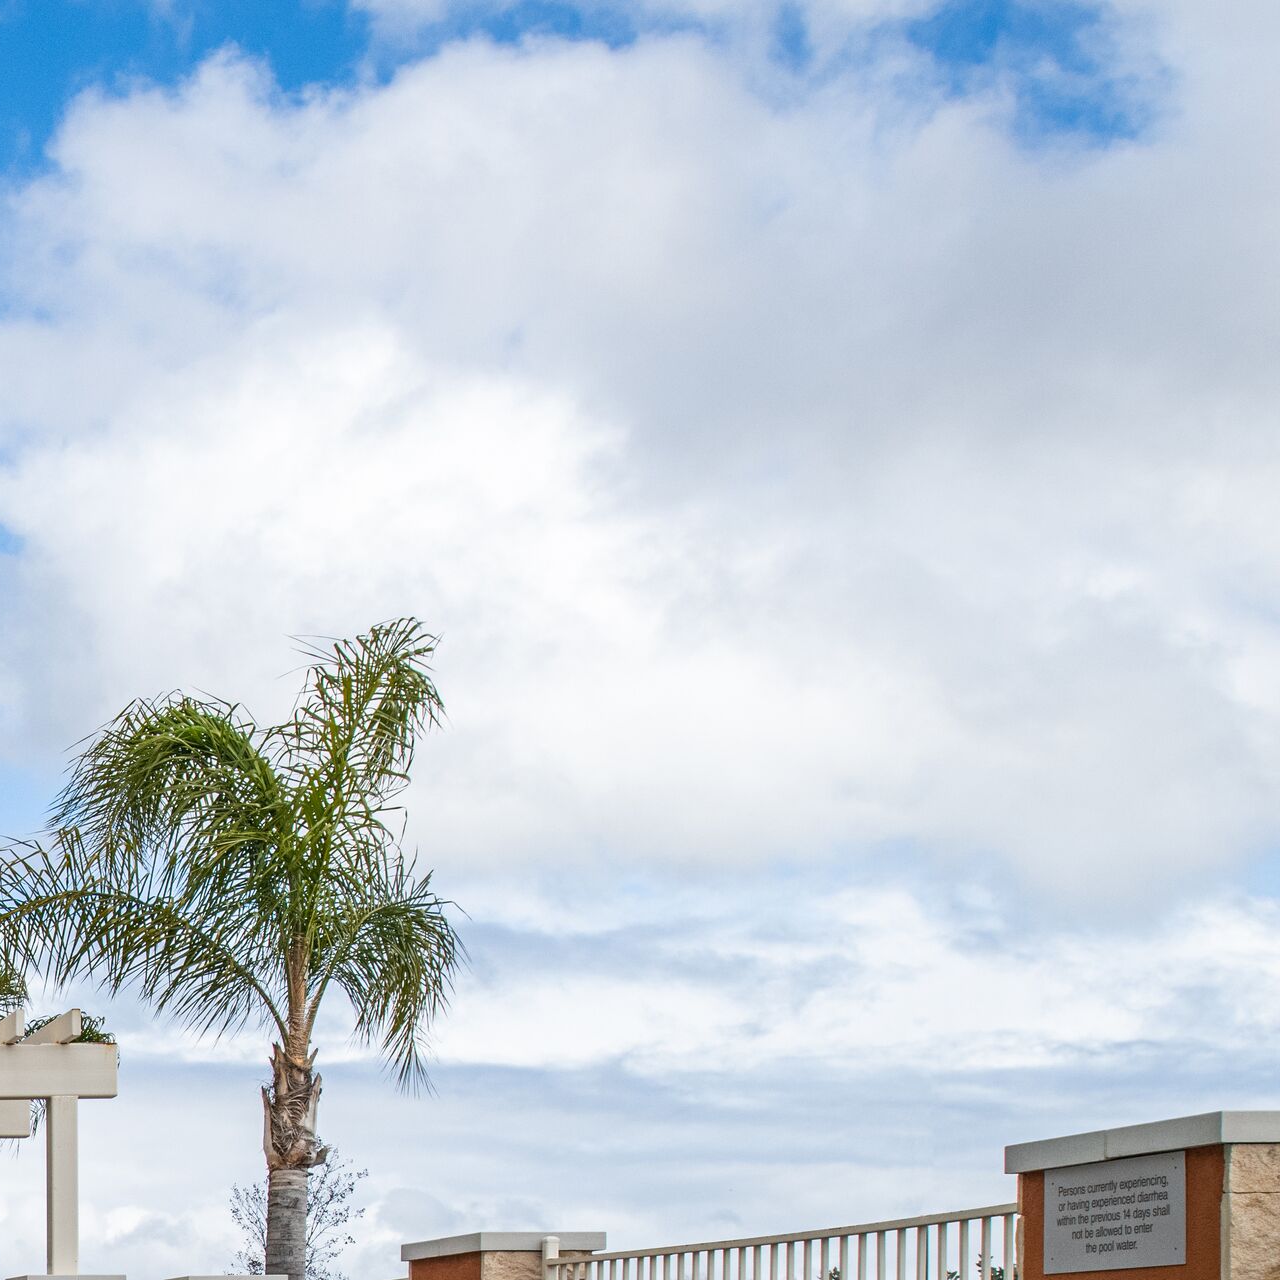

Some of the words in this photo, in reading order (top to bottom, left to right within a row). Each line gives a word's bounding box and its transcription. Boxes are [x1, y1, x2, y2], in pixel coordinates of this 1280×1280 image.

[1058, 1185, 1086, 1197] Persons
[1087, 1180, 1118, 1194] currently
[1120, 1175, 1168, 1191] experiencing,
[1058, 1203, 1066, 1212] or
[1067, 1199, 1089, 1211] having
[1092, 1194, 1136, 1211] experienced
[1138, 1190, 1168, 1203] diarrhea
[1057, 1215, 1076, 1227] within
[1078, 1214, 1089, 1225] the
[1090, 1211, 1120, 1226] previous
[1123, 1210, 1131, 1219] 14
[1133, 1207, 1151, 1221] days
[1152, 1204, 1170, 1217] shall
[1072, 1230, 1083, 1240] not
[1084, 1228, 1094, 1239] be
[1096, 1225, 1122, 1238] allowed
[1125, 1225, 1132, 1235] to
[1134, 1223, 1154, 1234] enter
[1086, 1243, 1097, 1253] the
[1098, 1241, 1114, 1255] pool
[1116, 1240, 1138, 1251] water.
